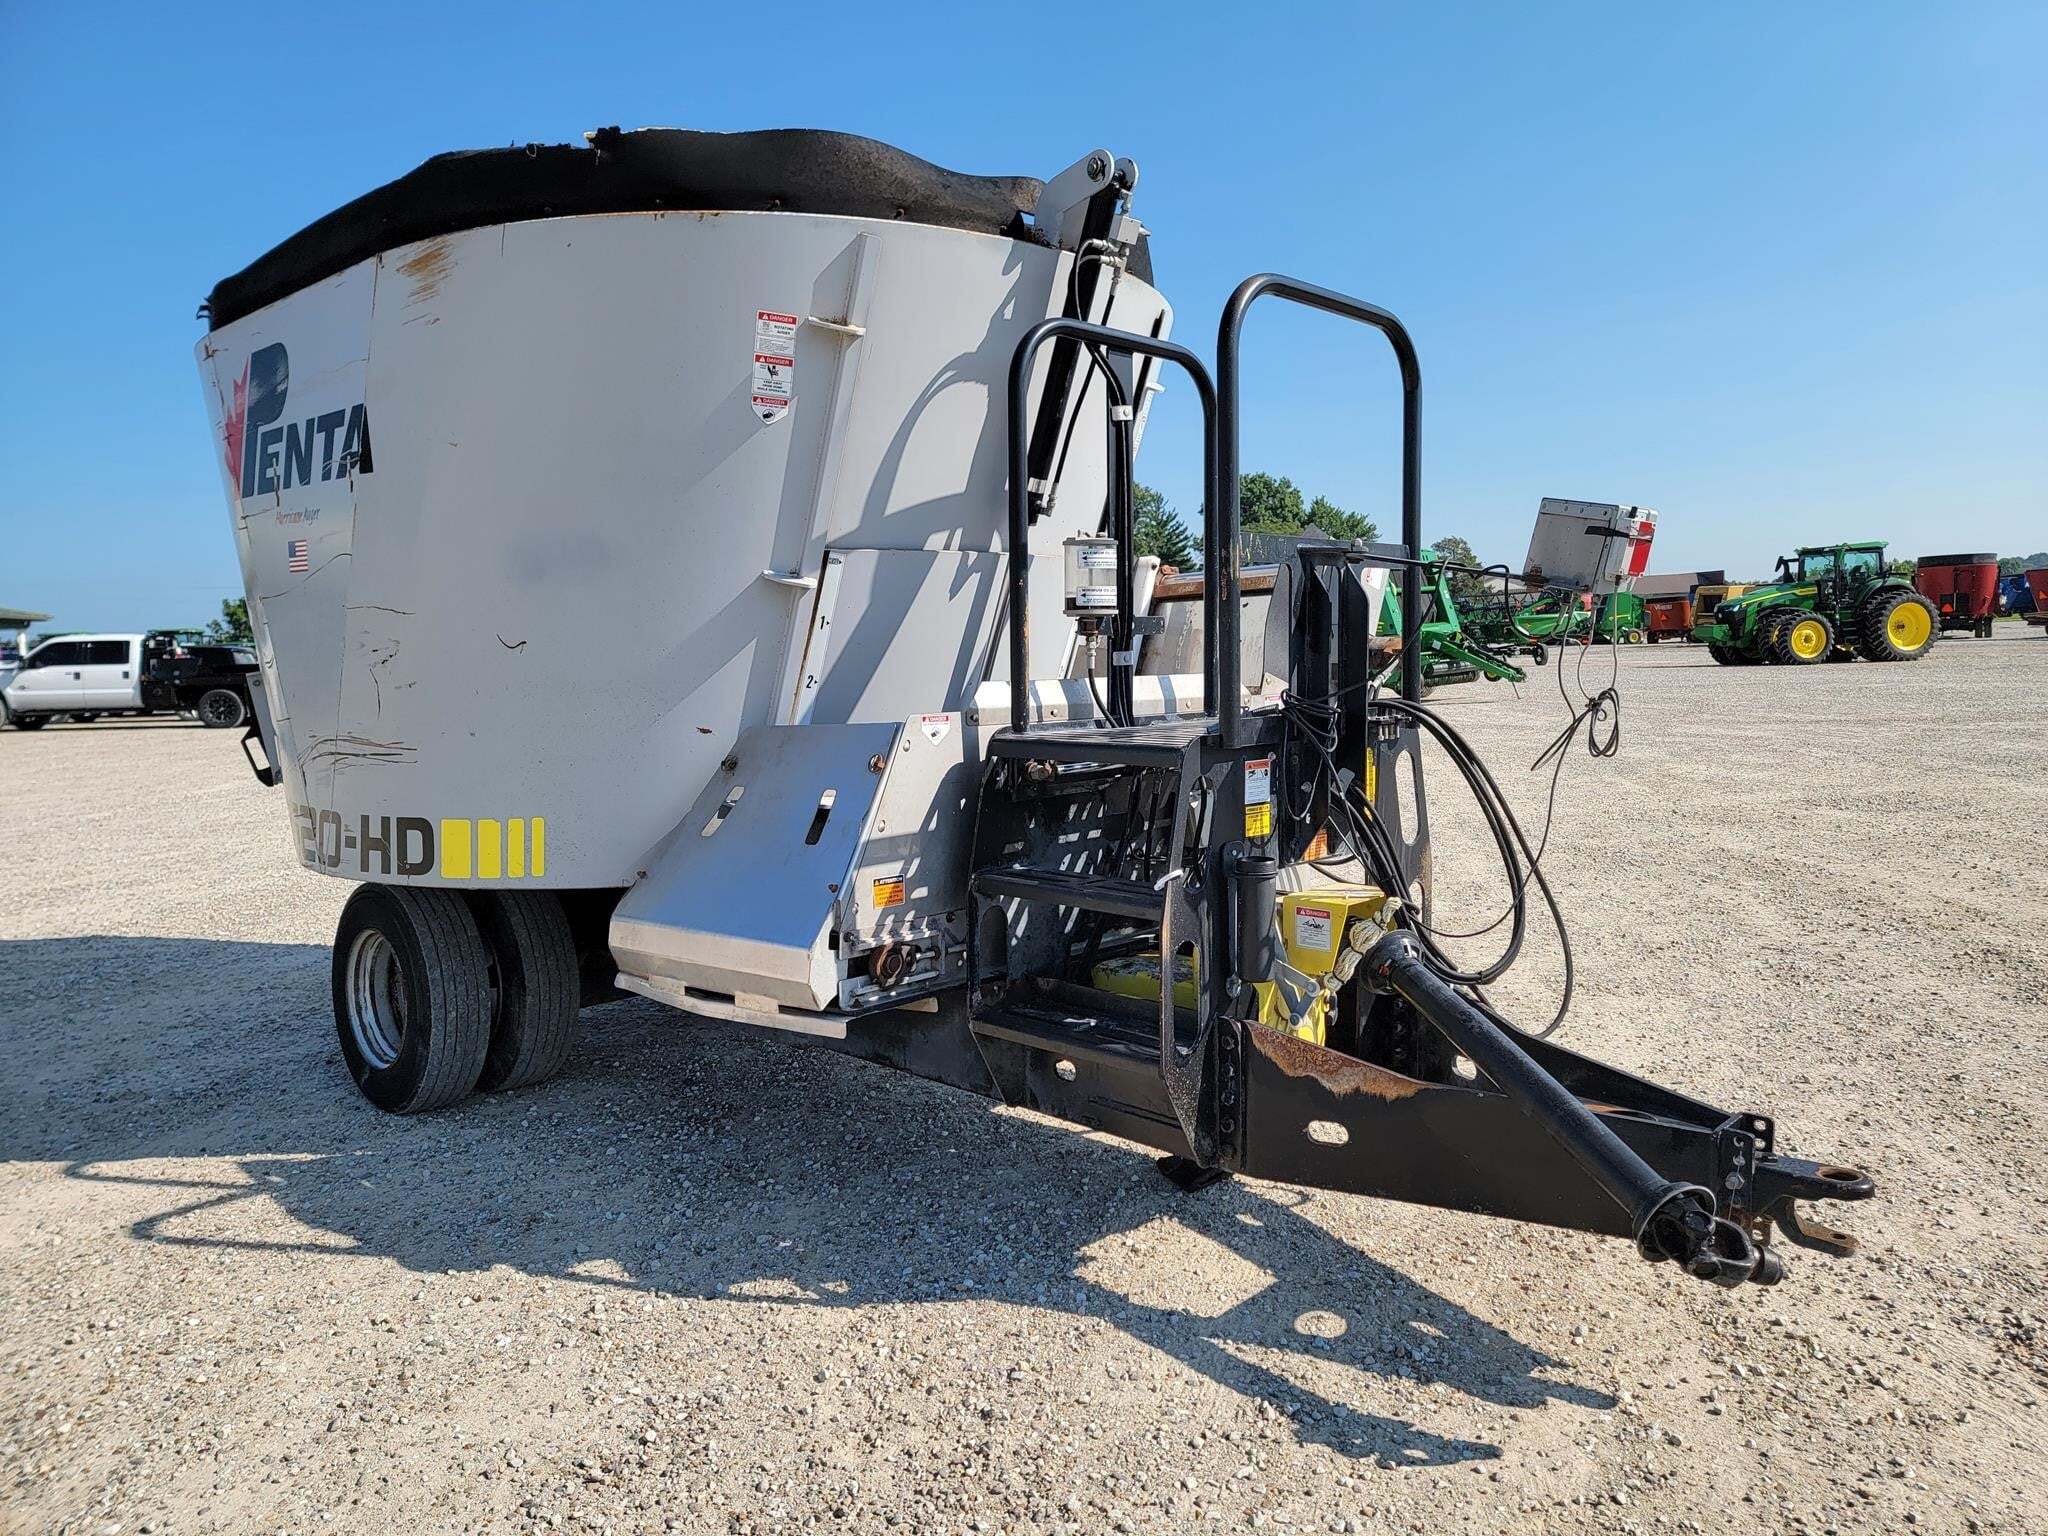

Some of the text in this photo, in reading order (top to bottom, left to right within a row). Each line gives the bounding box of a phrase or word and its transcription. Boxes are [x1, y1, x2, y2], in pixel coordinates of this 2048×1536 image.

[769, 314, 793, 323] DANGER
[766, 357, 790, 366] DANGER
[762, 398, 785, 406] DANGER
[242, 342, 374, 499] PENTA
[820, 615, 826, 630] 1
[806, 674, 814, 689] 2
